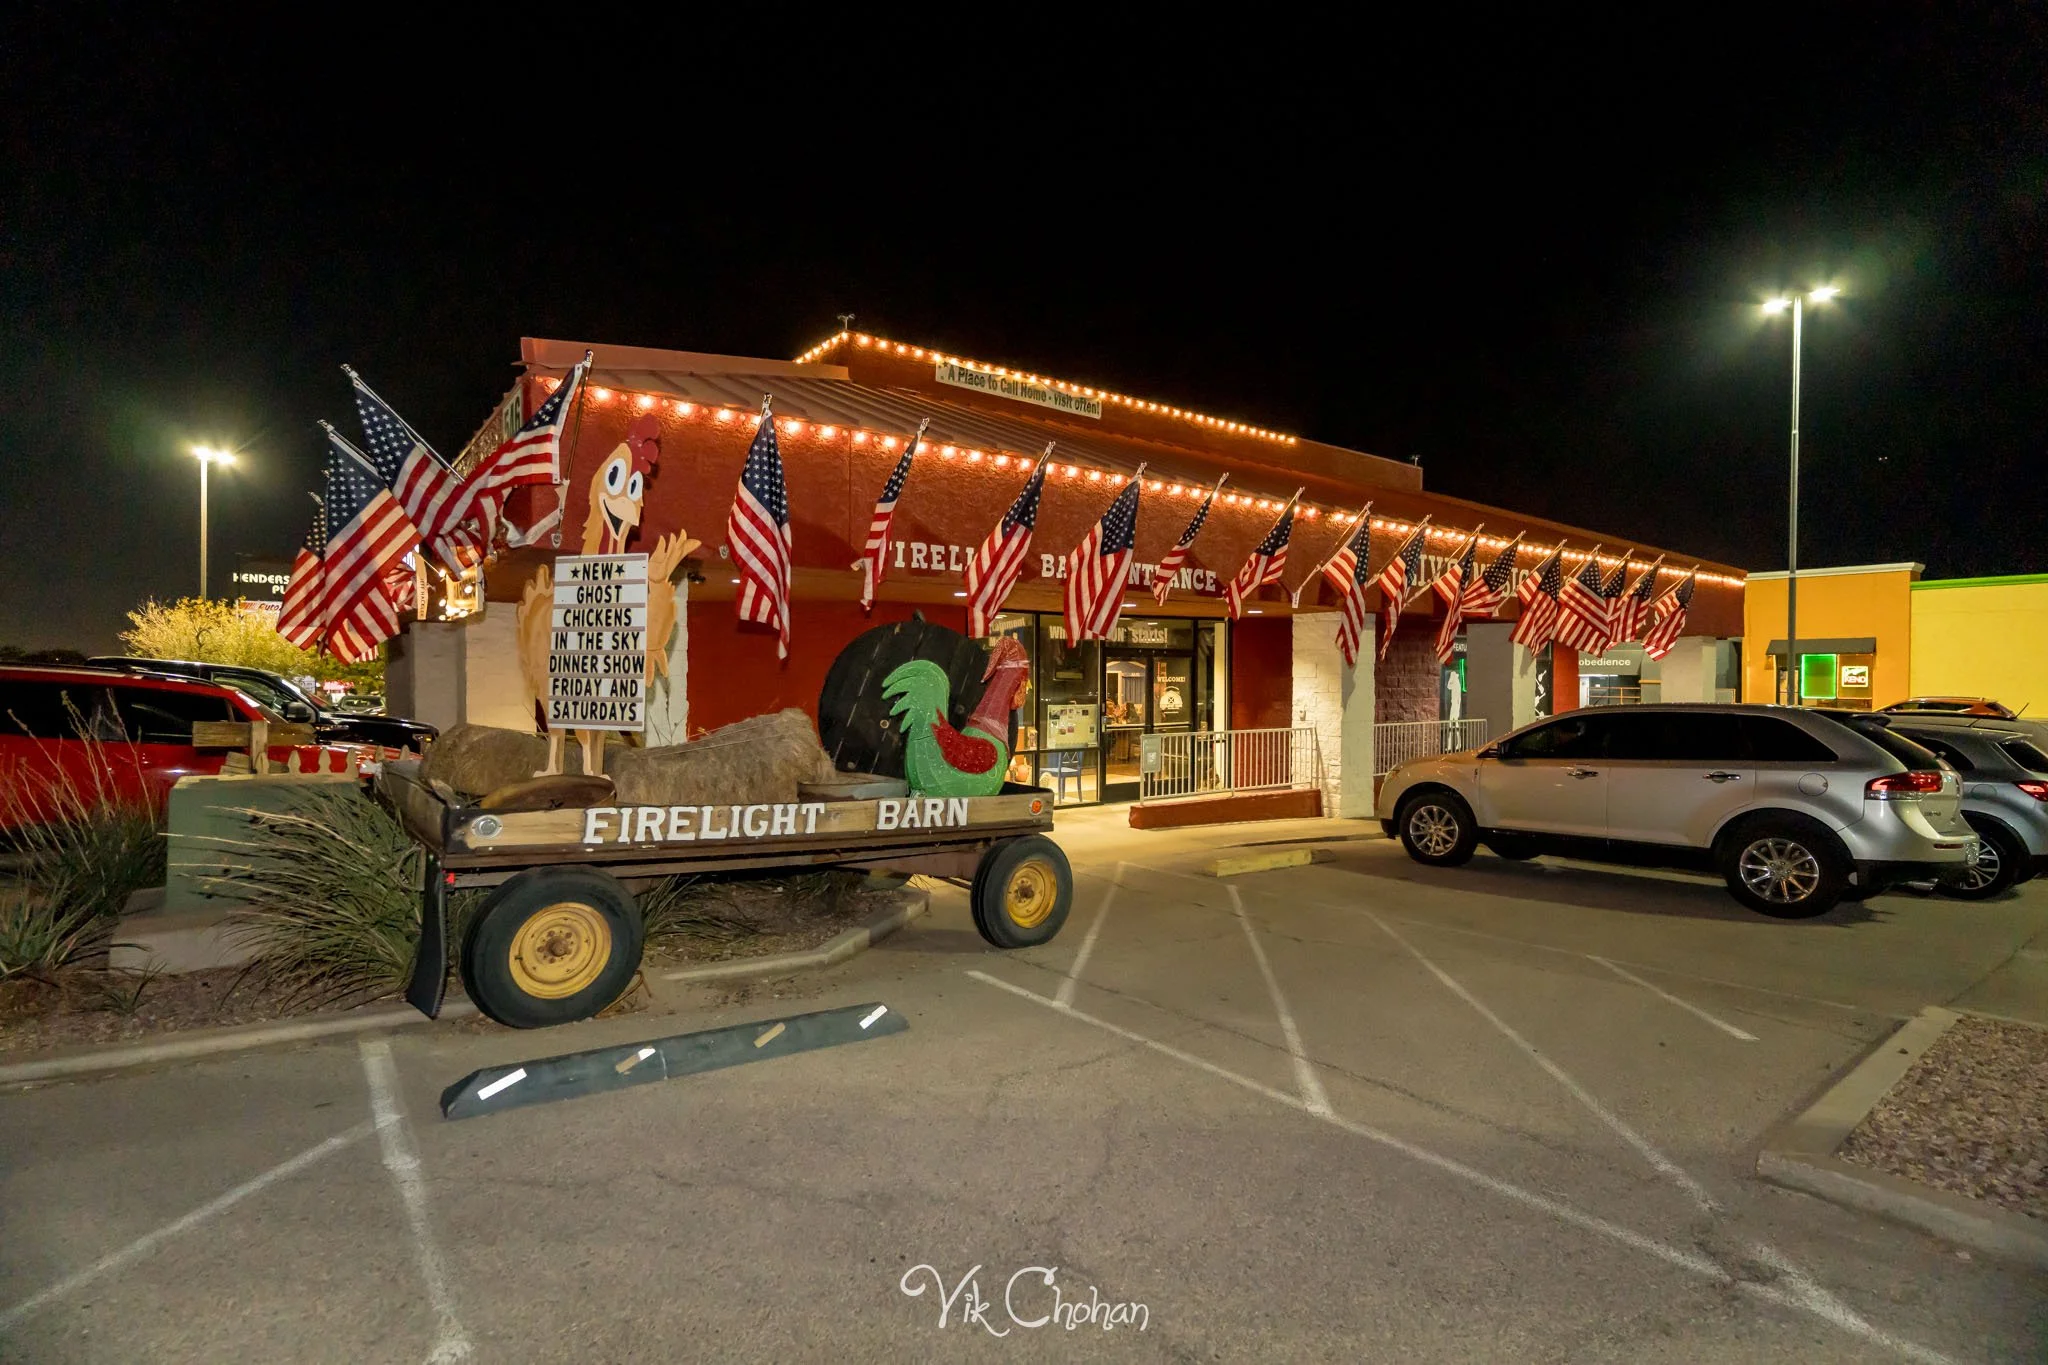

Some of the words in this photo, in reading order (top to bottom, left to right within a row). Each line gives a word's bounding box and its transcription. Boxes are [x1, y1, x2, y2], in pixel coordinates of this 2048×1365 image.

[958, 367, 985, 388] Place
[988, 374, 998, 391] to
[1001, 377, 1018, 396] Call
[1020, 382, 1046, 402] Home
[1075, 397, 1099, 416] often!
[233, 573, 290, 585] HENDERS
[582, 562, 613, 580] NEW
[1129, 561, 1217, 592] NTANCE
[577, 585, 622, 604] GHOST
[563, 608, 632, 627] CHICKENS
[555, 632, 568, 650] IN
[577, 632, 603, 650] THE
[611, 632, 639, 650] SKY
[549, 655, 598, 673] DINNER
[603, 654, 645, 674] SHOW
[1578, 658, 1631, 667] obedience
[552, 678, 602, 696] FRIDAY
[610, 678, 638, 697] AND
[552, 701, 637, 721] SATURDAYS
[582, 802, 825, 844] FIRELIGHT
[876, 798, 969, 830] BARN
